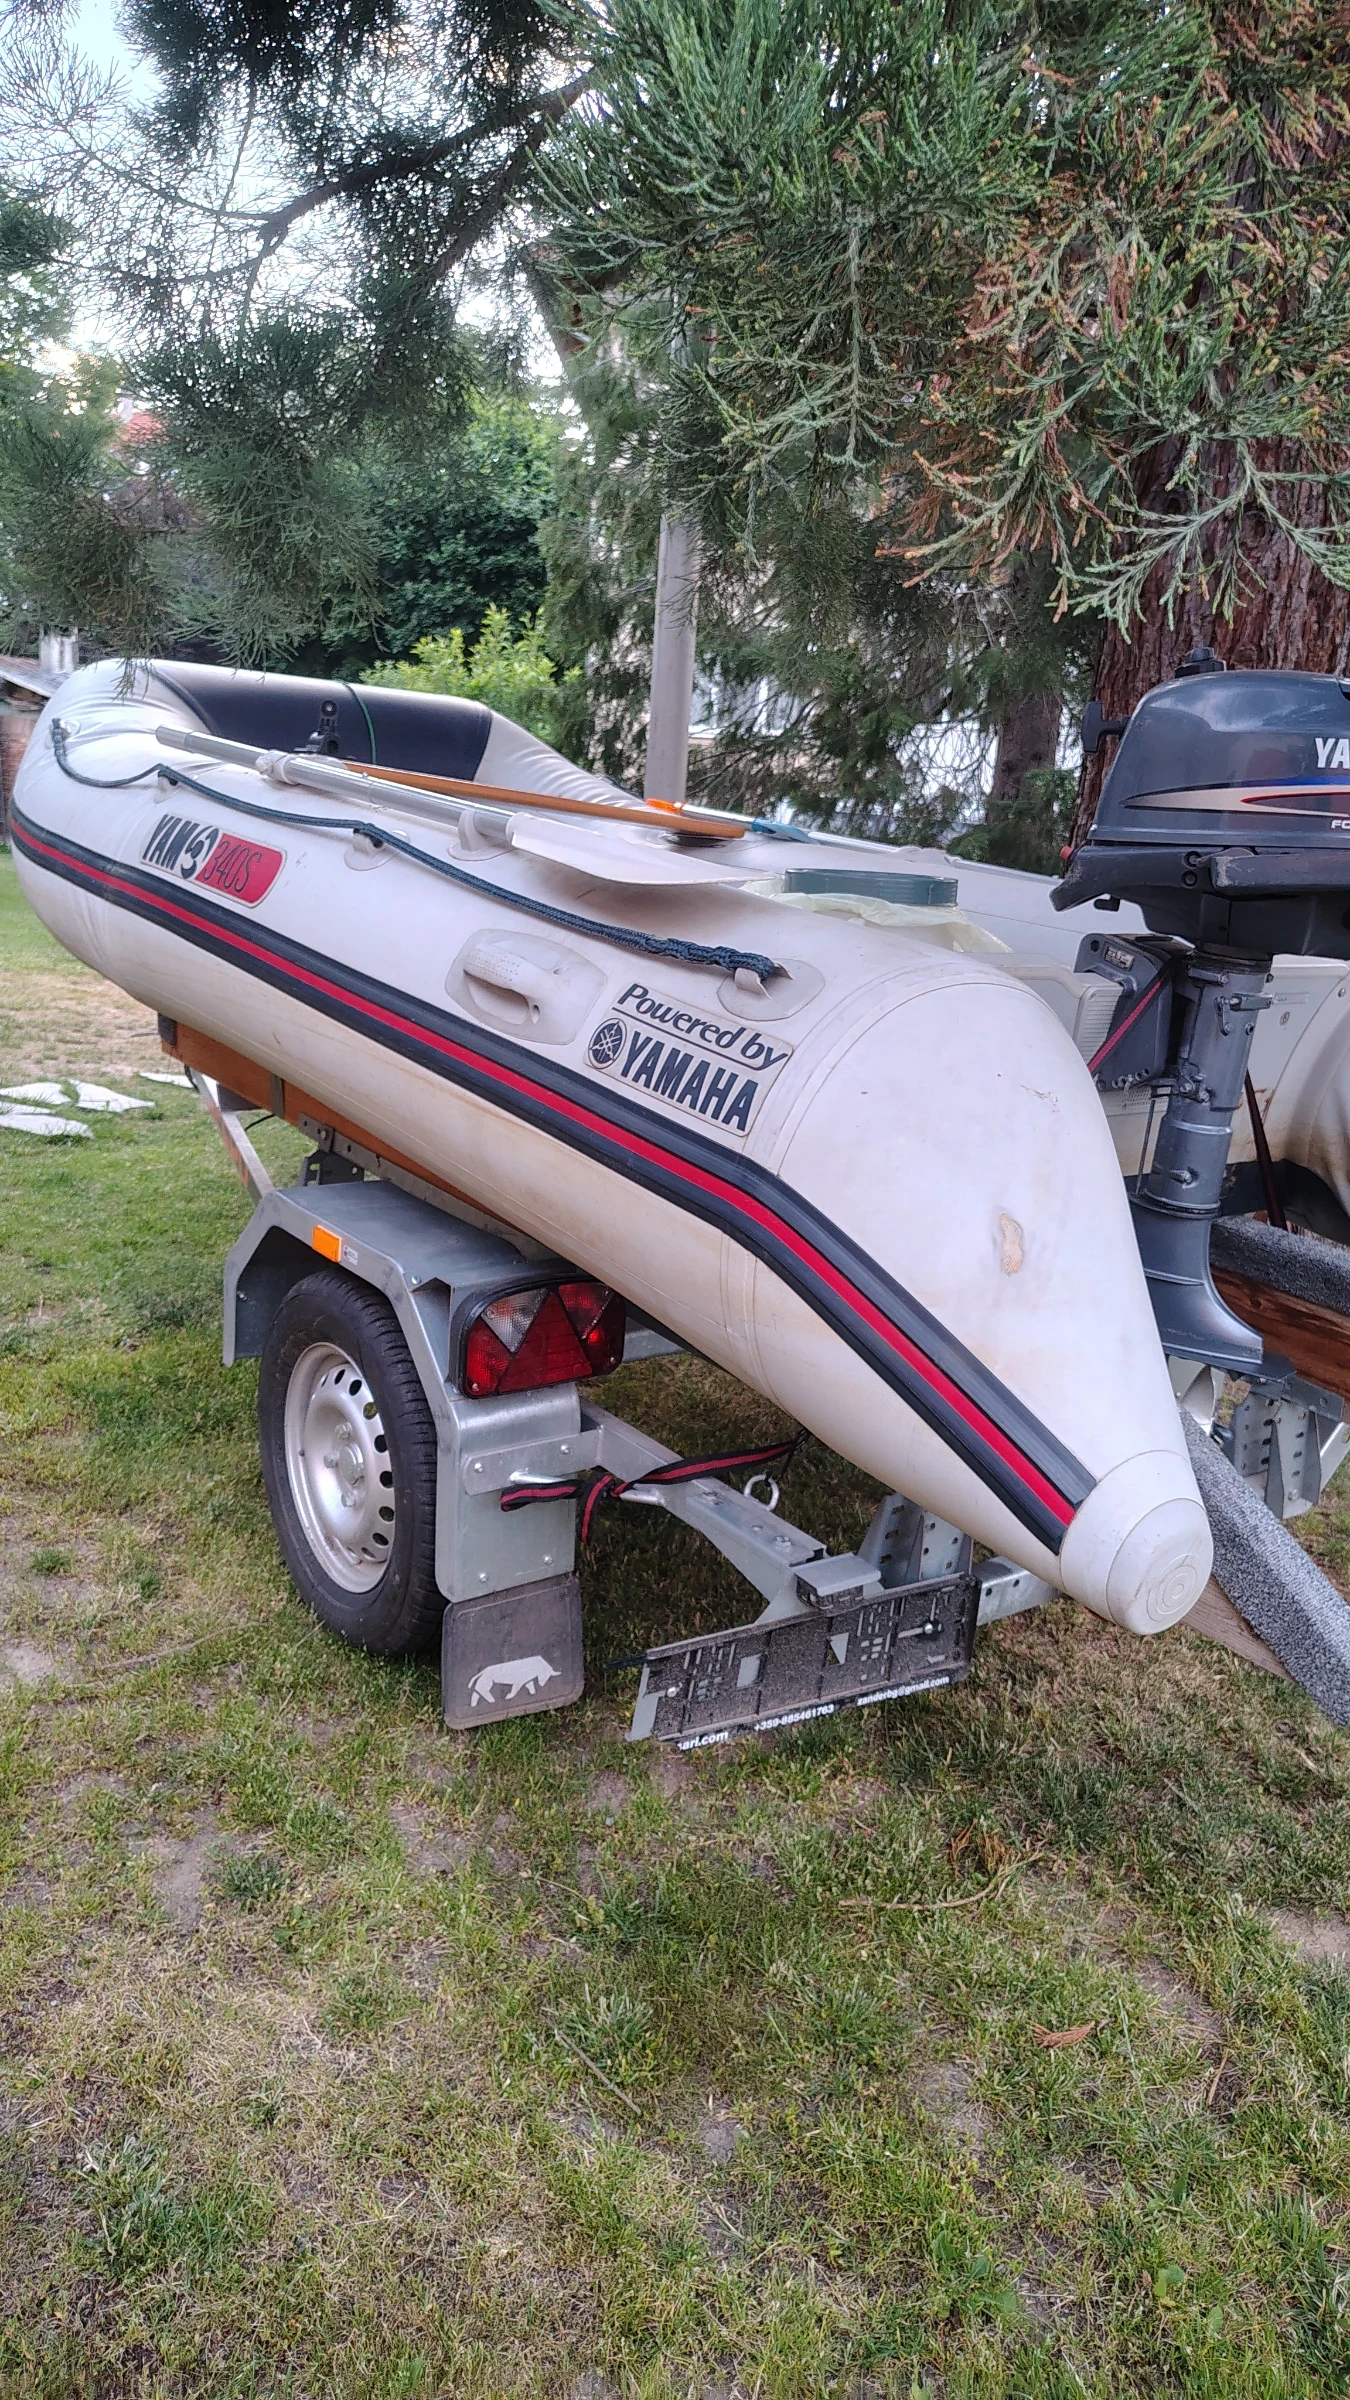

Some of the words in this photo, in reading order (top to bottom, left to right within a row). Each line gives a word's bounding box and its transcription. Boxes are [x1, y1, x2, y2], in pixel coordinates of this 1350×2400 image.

[203, 840, 263, 893] 340S
[617, 983, 747, 1049] Powered
[741, 1032, 788, 1070] by
[620, 1030, 759, 1132] YAMAHA
[856, 1676, 950, 1706] zanderbg@gmail.com
